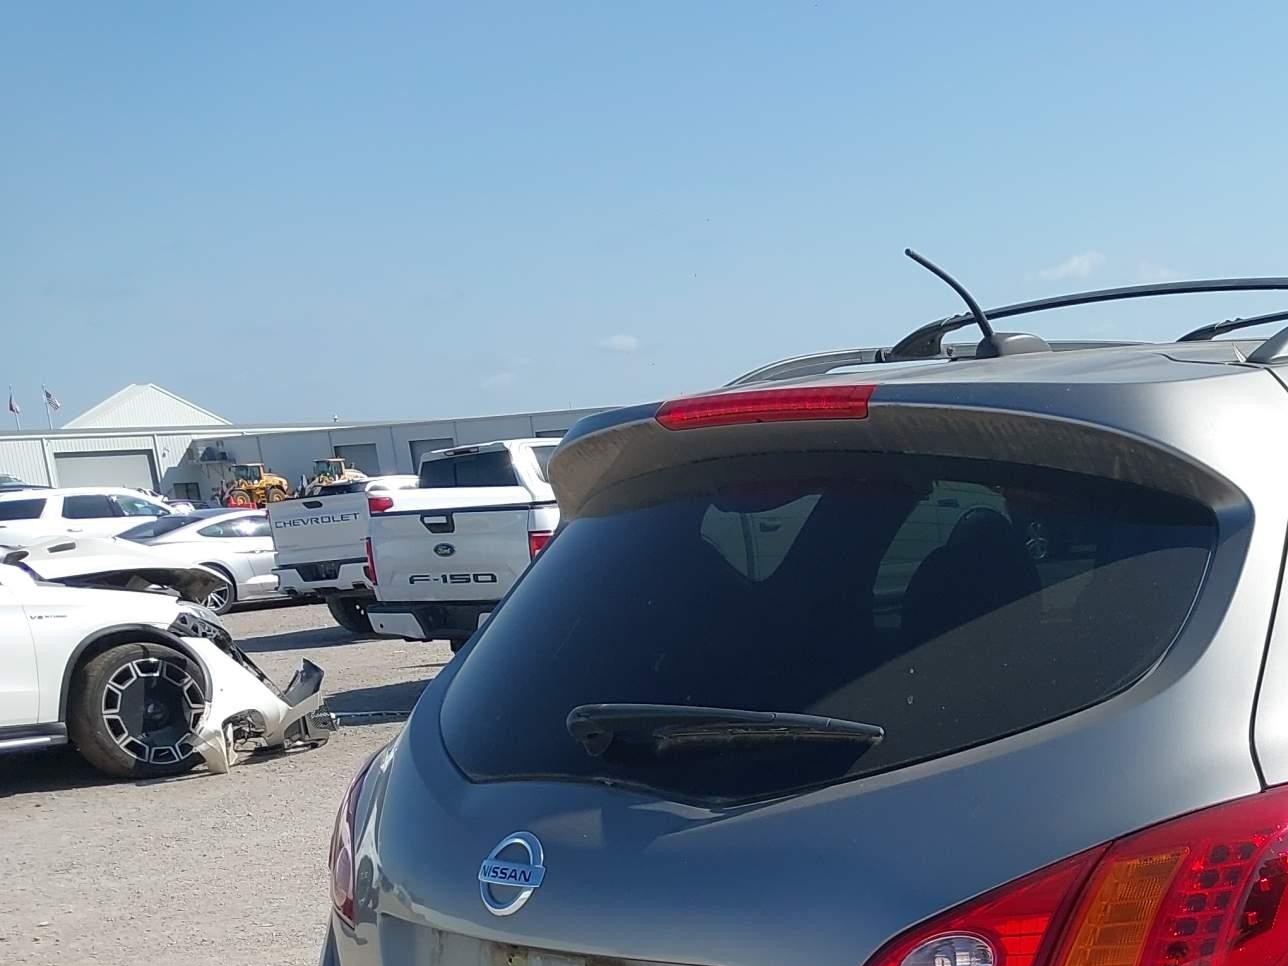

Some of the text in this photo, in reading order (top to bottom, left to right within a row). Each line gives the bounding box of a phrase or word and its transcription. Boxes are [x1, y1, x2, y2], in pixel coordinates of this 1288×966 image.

[274, 511, 361, 529] CHEVROLET
[408, 573, 499, 585] F-150
[480, 863, 533, 883] NISSAN
